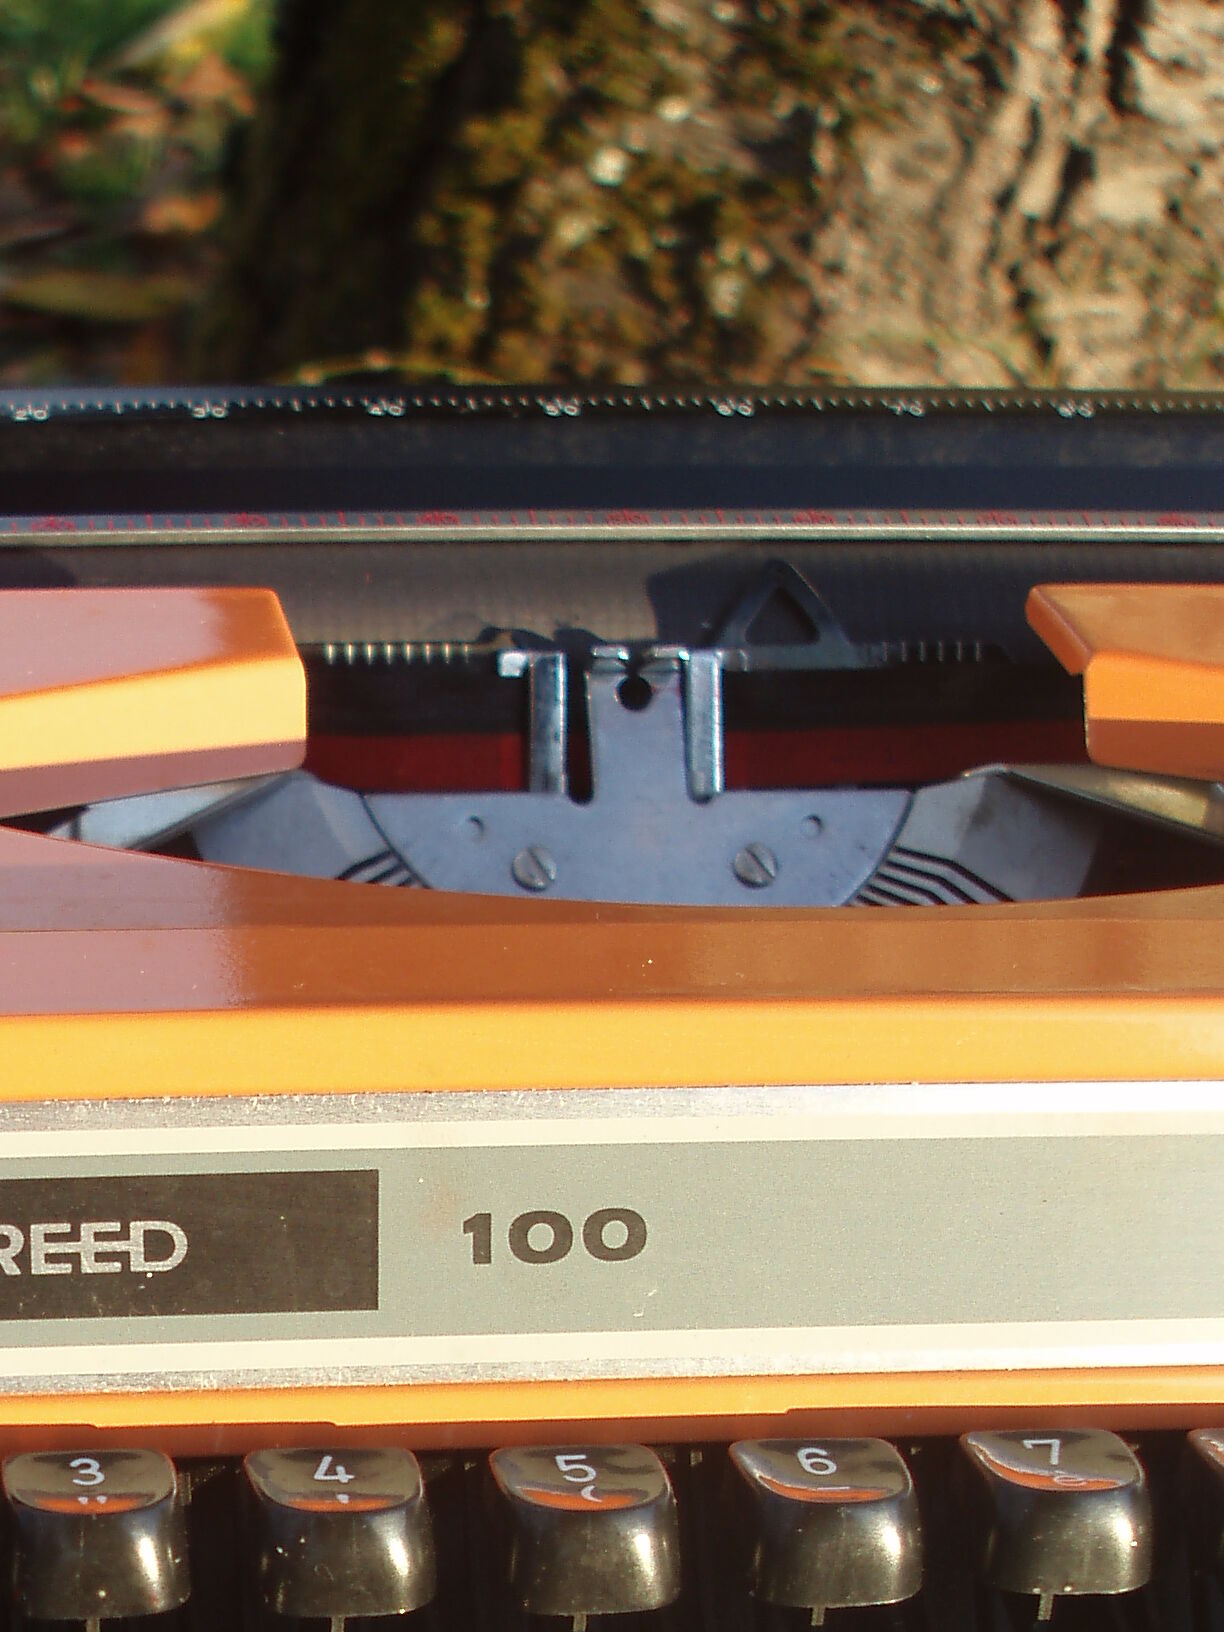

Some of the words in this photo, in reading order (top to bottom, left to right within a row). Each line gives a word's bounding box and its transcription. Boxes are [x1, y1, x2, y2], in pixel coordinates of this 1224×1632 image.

[464, 1208, 646, 1264] 100
[797, 1447, 837, 1475] 6
[1023, 1438, 1061, 1466] 7
[69, 1458, 105, 1486] 3
[313, 1455, 355, 1484] 4
[555, 1454, 597, 1483] 5
